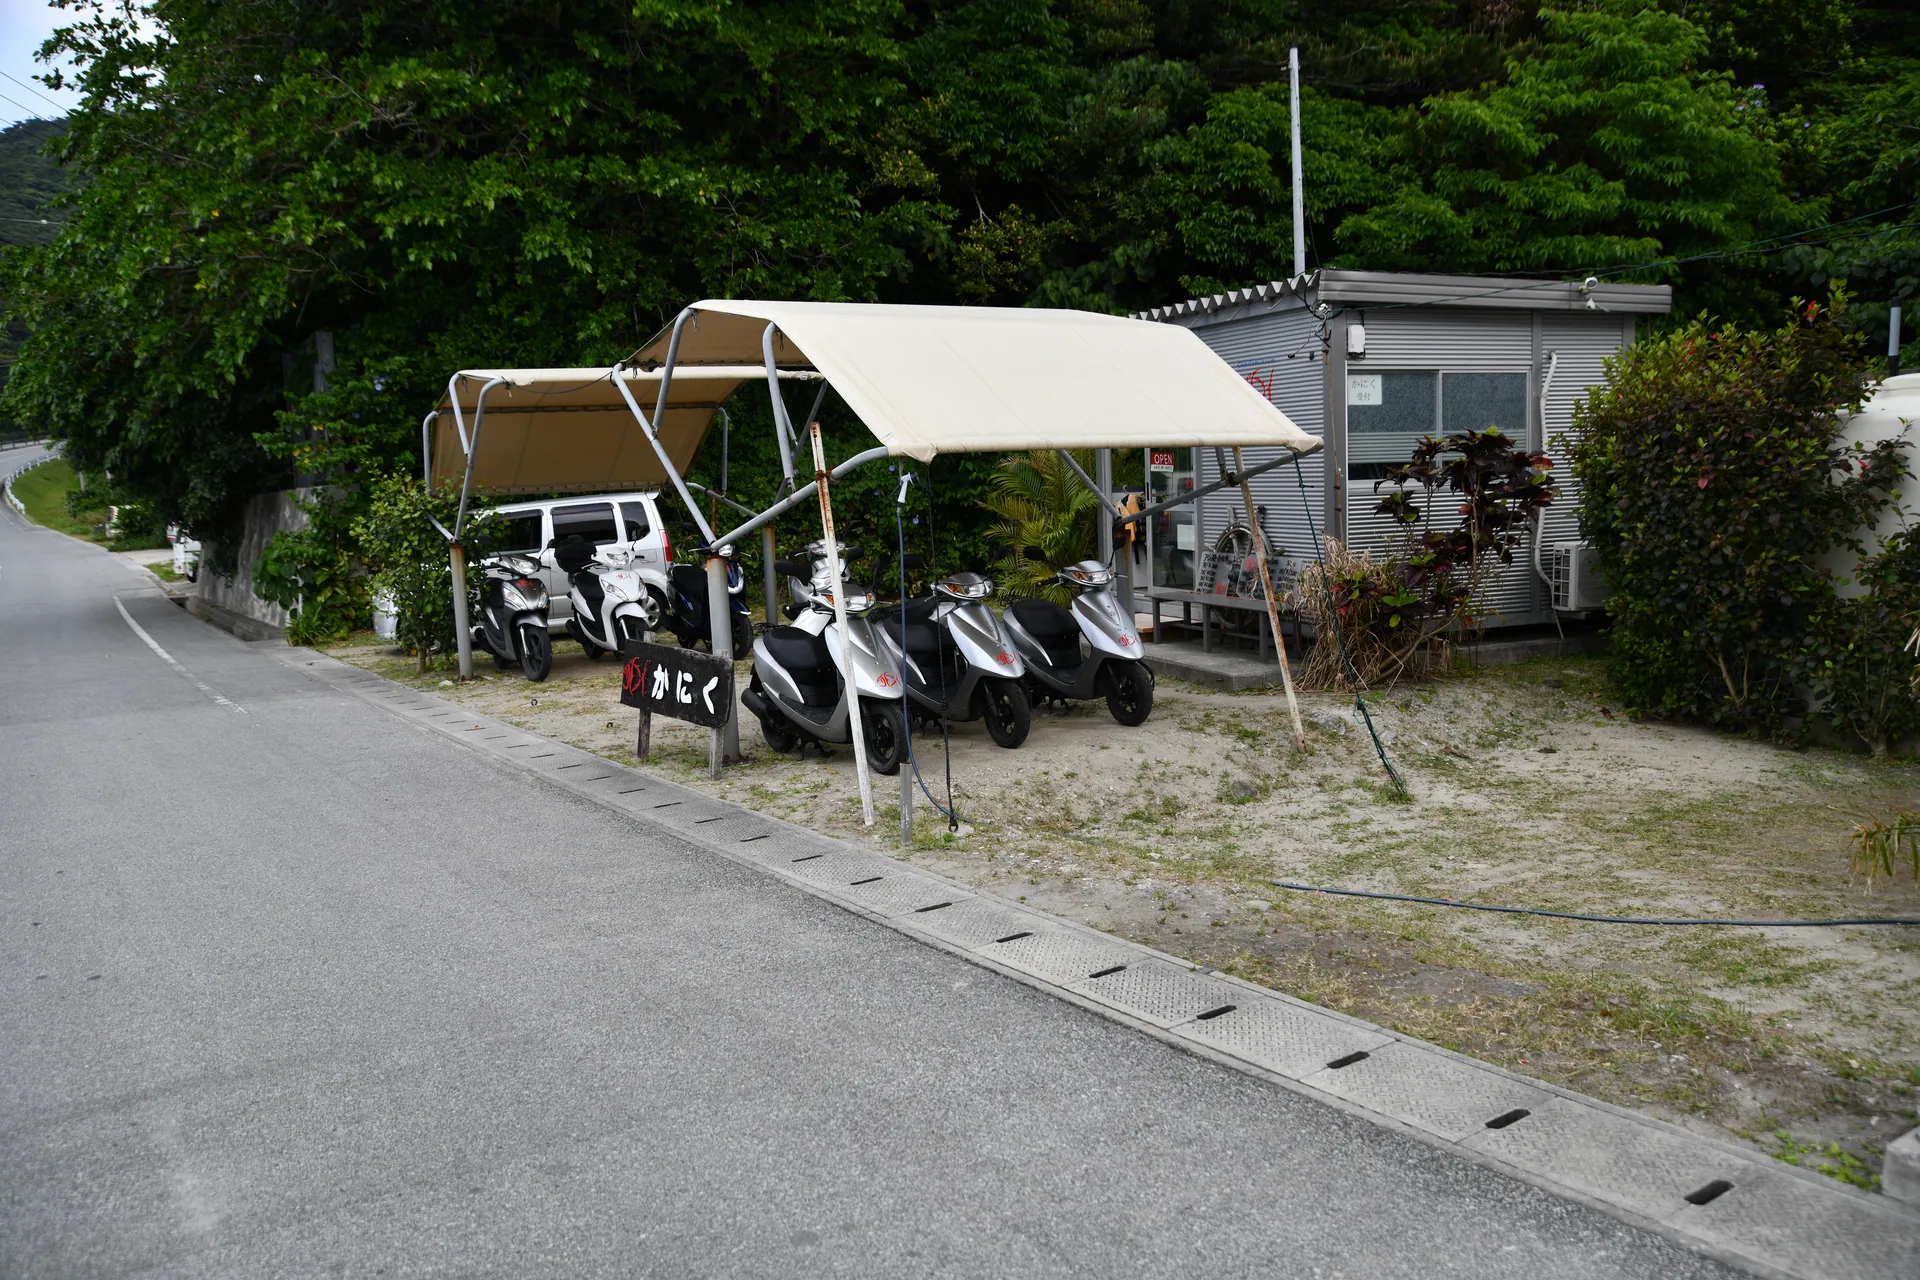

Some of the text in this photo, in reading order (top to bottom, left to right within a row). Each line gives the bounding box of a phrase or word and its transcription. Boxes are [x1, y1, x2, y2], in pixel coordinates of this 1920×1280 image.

[1352, 378, 1376, 389] かにく
[1356, 391, 1371, 401] 受付
[1154, 454, 1173, 464] OPEN
[651, 663, 719, 715] かにく
